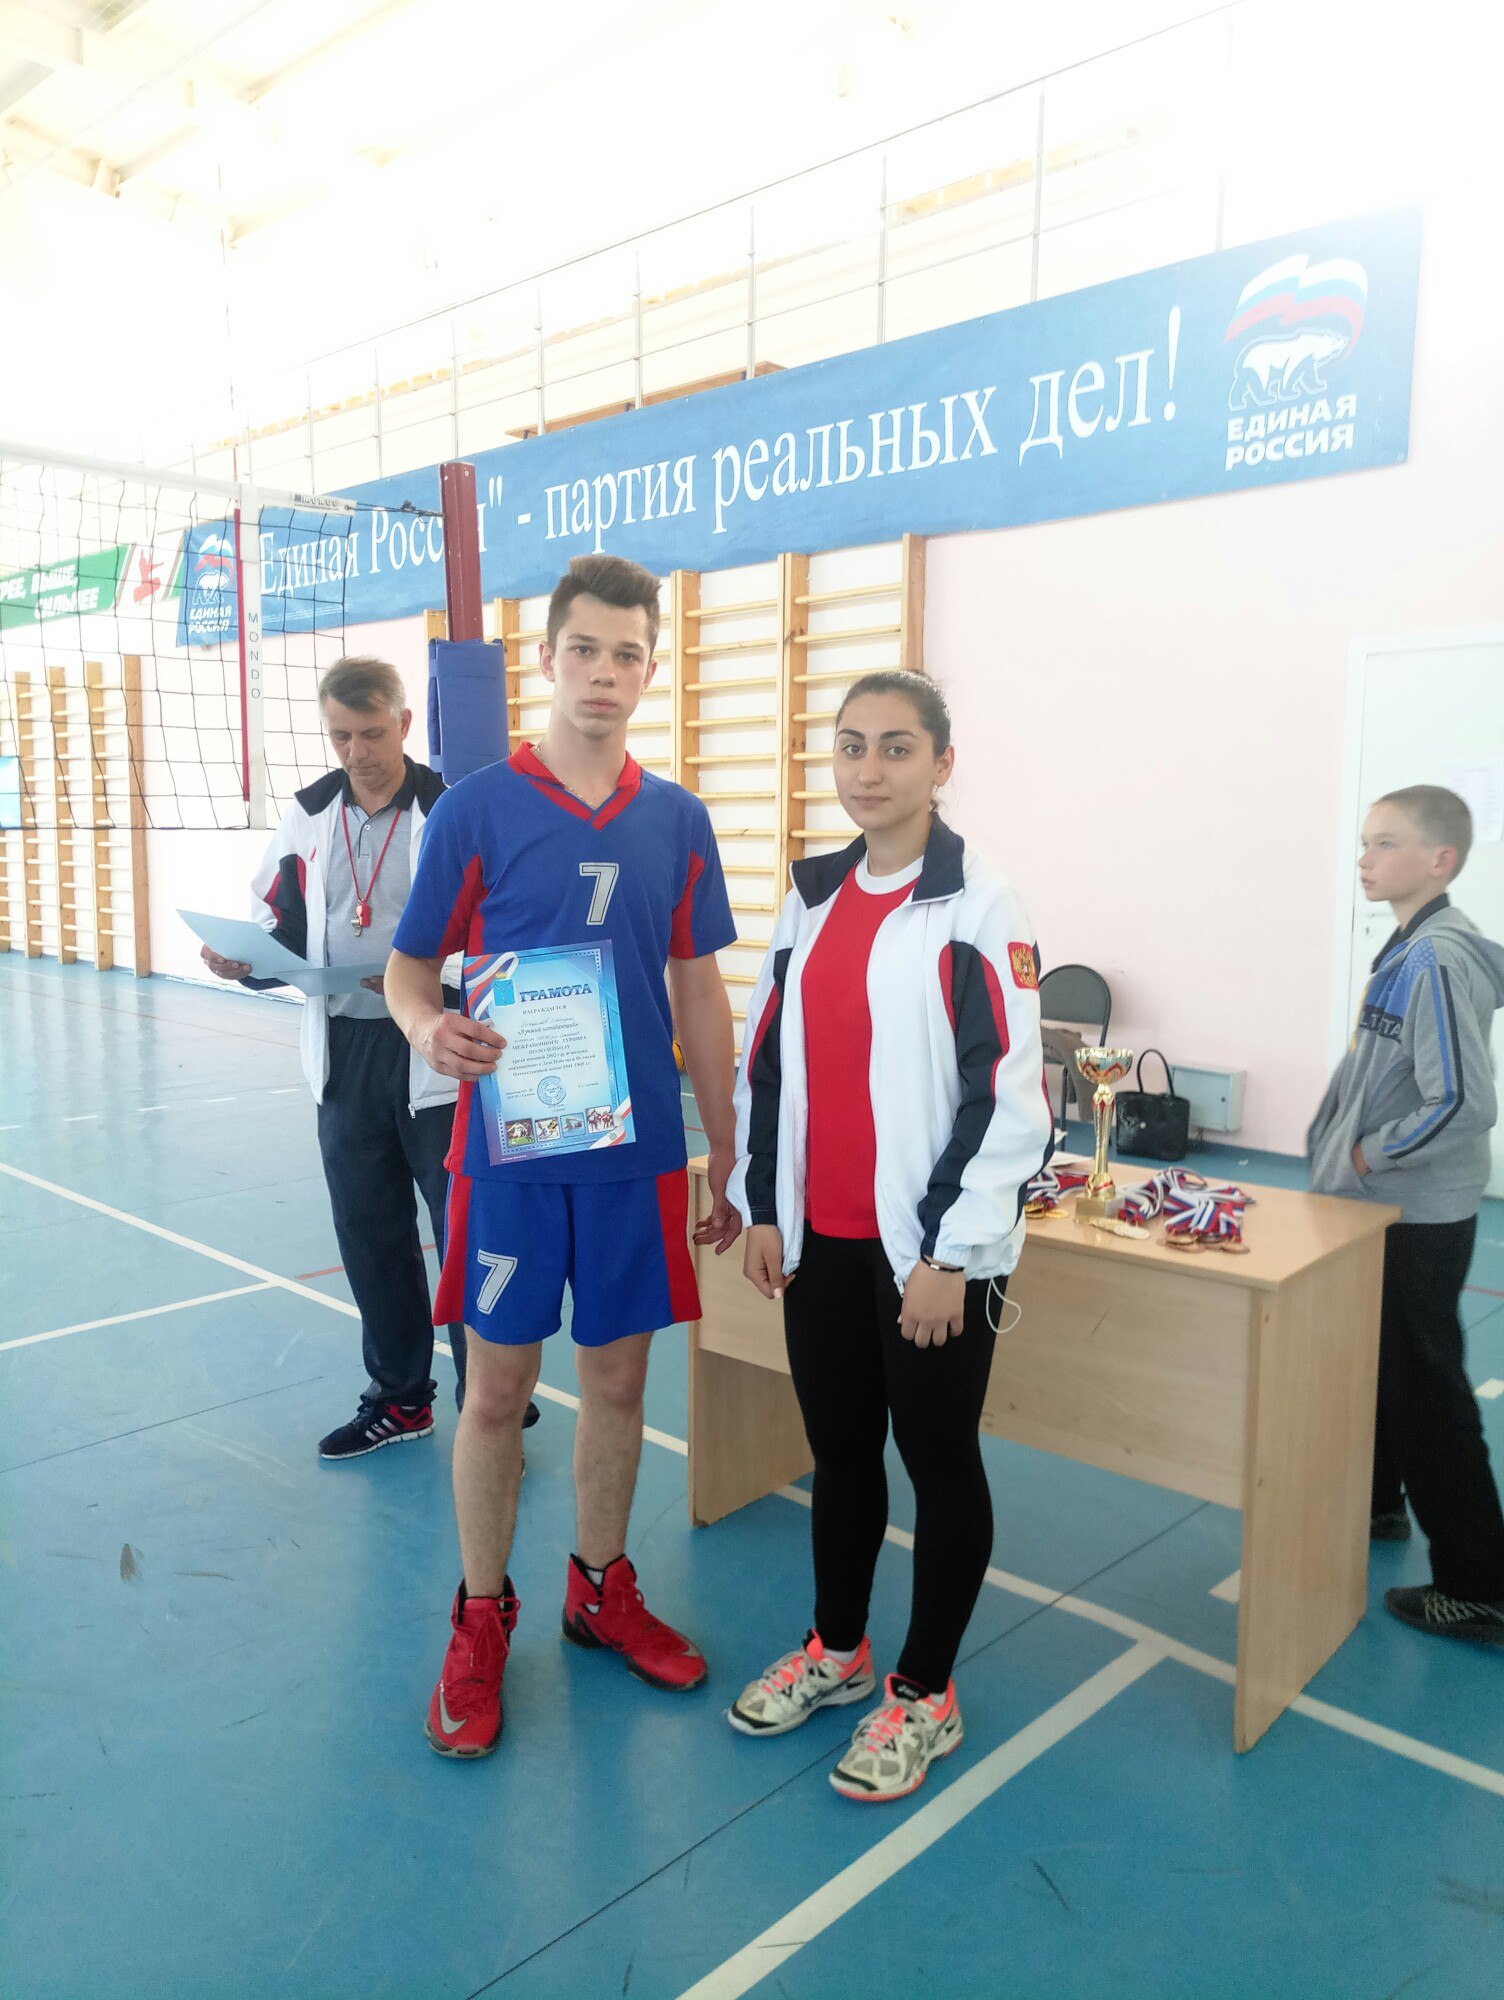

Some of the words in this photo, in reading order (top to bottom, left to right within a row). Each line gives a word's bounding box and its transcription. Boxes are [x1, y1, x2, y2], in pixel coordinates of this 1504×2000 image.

[369, 474, 503, 574] Росс"
[544, 454, 697, 554] партия
[712, 385, 999, 534] реальных
[1017, 304, 1182, 467] дел!
[1226, 392, 1358, 443] ЕДИНАЯ
[1224, 423, 1355, 472] РОССИЯ
[34, 586, 100, 620] СИЛЬНЕЕ
[188, 619, 231, 635] РОССИЯ
[189, 605, 232, 621] ЕДИНАЯ
[248, 612, 262, 699] MONDO
[578, 862, 620, 927] 7
[519, 983, 593, 1003] ГРАМОТА
[475, 1248, 518, 1317] 7
